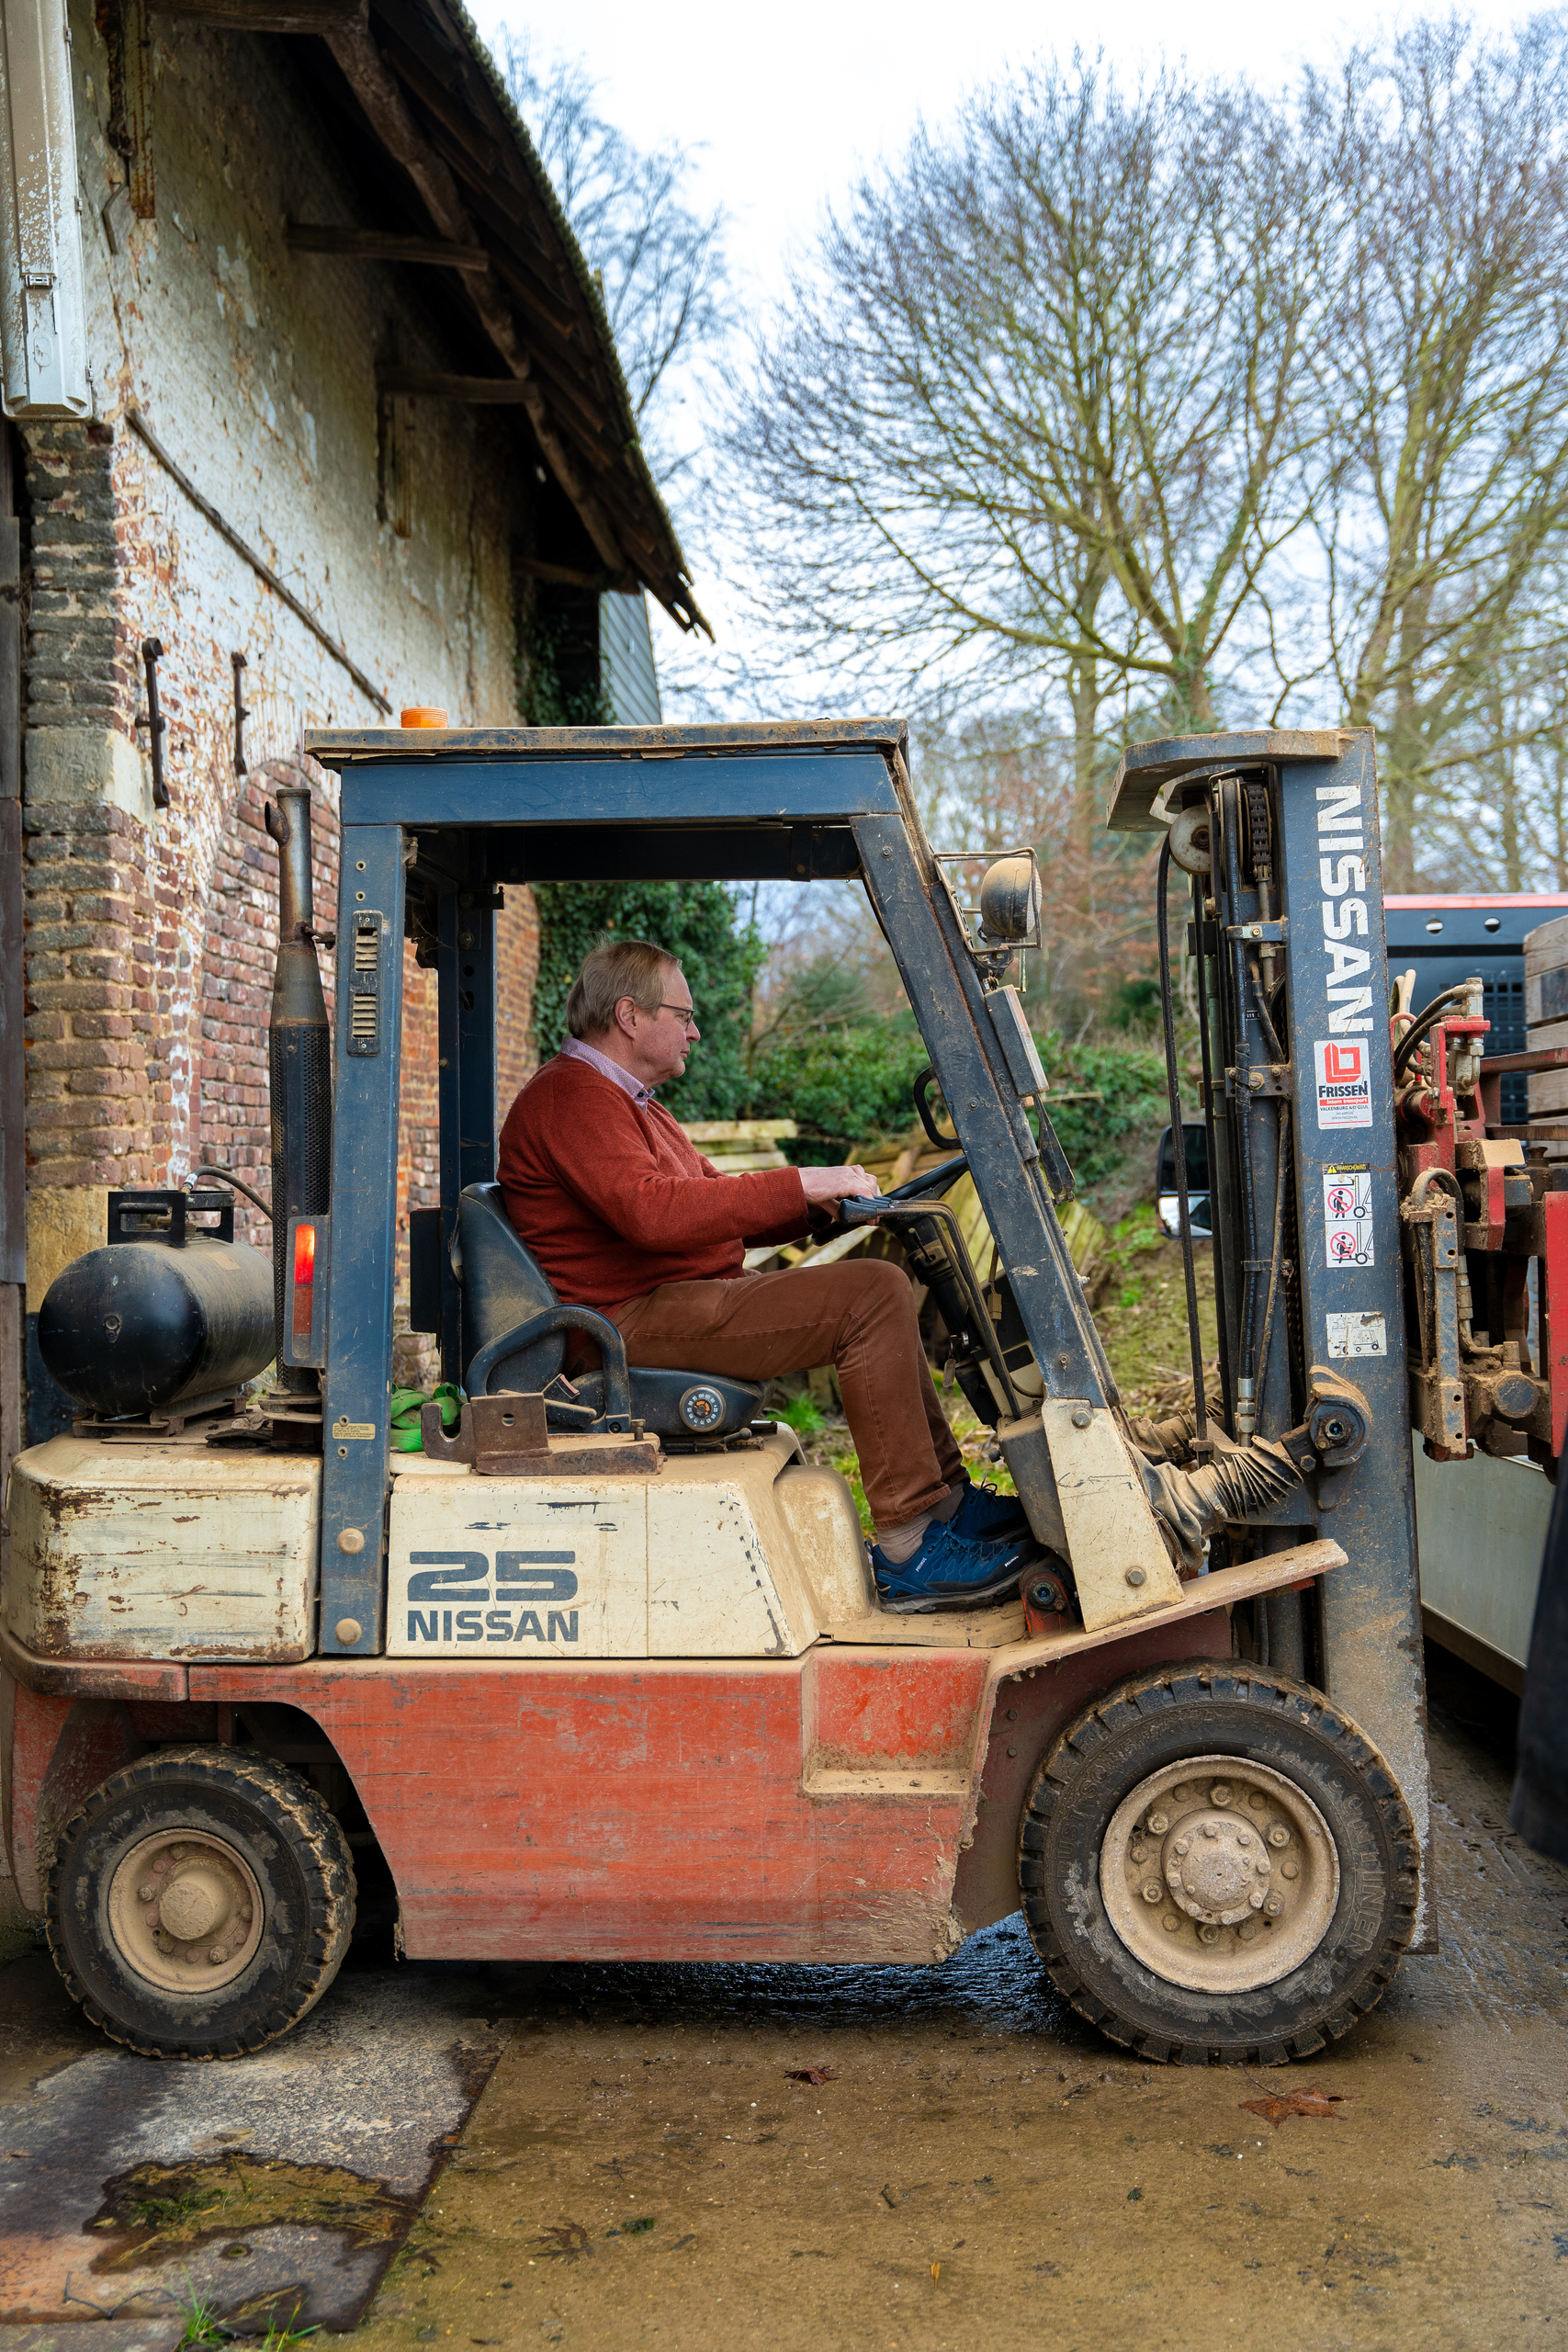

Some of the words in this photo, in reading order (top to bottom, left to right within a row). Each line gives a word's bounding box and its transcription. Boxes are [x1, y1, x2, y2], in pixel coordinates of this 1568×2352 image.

[1316, 785, 1373, 1034] NISSAN
[1318, 1080, 1369, 1098] FRISSEN
[408, 1551, 578, 1601] 25
[408, 1610, 578, 1642] NISSAN
[1286, 1767, 1387, 2018] CONTINENTAL
